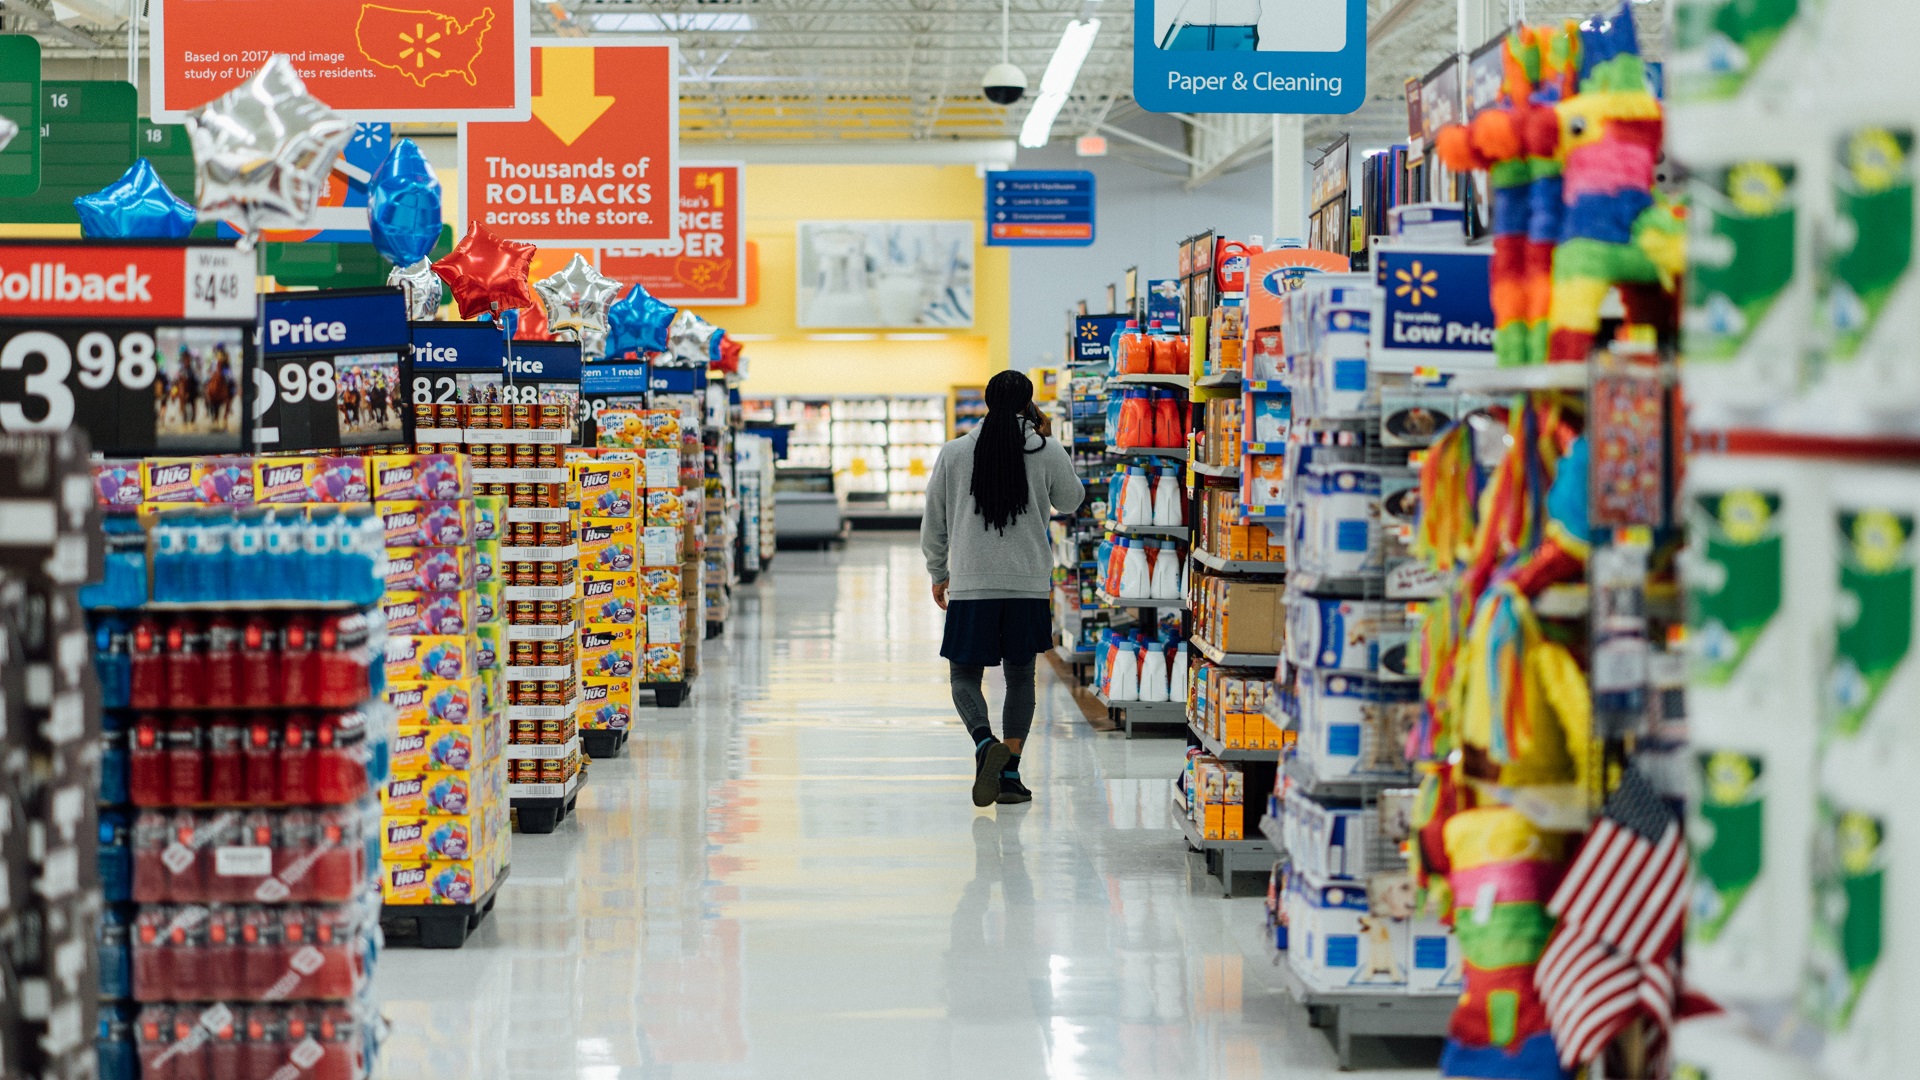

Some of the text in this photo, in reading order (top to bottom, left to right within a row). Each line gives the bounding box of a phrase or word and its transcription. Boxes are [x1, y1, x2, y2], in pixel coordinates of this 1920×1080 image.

[184, 51, 220, 62] Based
[223, 54, 238, 62] on
[242, 50, 268, 62] 2017
[309, 51, 344, 64] image
[184, 68, 216, 81] study
[220, 68, 233, 78] of
[319, 68, 376, 78] residents.
[1168, 71, 1342, 97] Paper & Cleaning
[50, 94, 68, 108] 16
[146, 129, 162, 143] 18
[485, 156, 651, 179] Thousands of
[486, 183, 652, 205] ROLLBACKS
[695, 172, 724, 208] #1
[486, 208, 653, 225] across the store.
[679, 212, 724, 230] RICE
[0, 263, 151, 301] ollback
[270, 316, 346, 345] Price
[1393, 322, 1444, 344] Low
[1446, 322, 1497, 344] Pric
[1082, 346, 1102, 356] Low
[618, 366, 642, 376] meal
[155, 468, 190, 486] HUG
[268, 468, 302, 487] HUG
[384, 468, 412, 485] HUG
[584, 474, 608, 487] HUG
[388, 514, 416, 530] HUG
[588, 582, 612, 596] HUG
[388, 605, 416, 620] HUG
[394, 690, 422, 706] HUG
[584, 688, 606, 700] HUG
[395, 736, 424, 753] HUG
[392, 782, 420, 797] HUG
[392, 827, 420, 843] HUG
[396, 870, 424, 886] HUG
